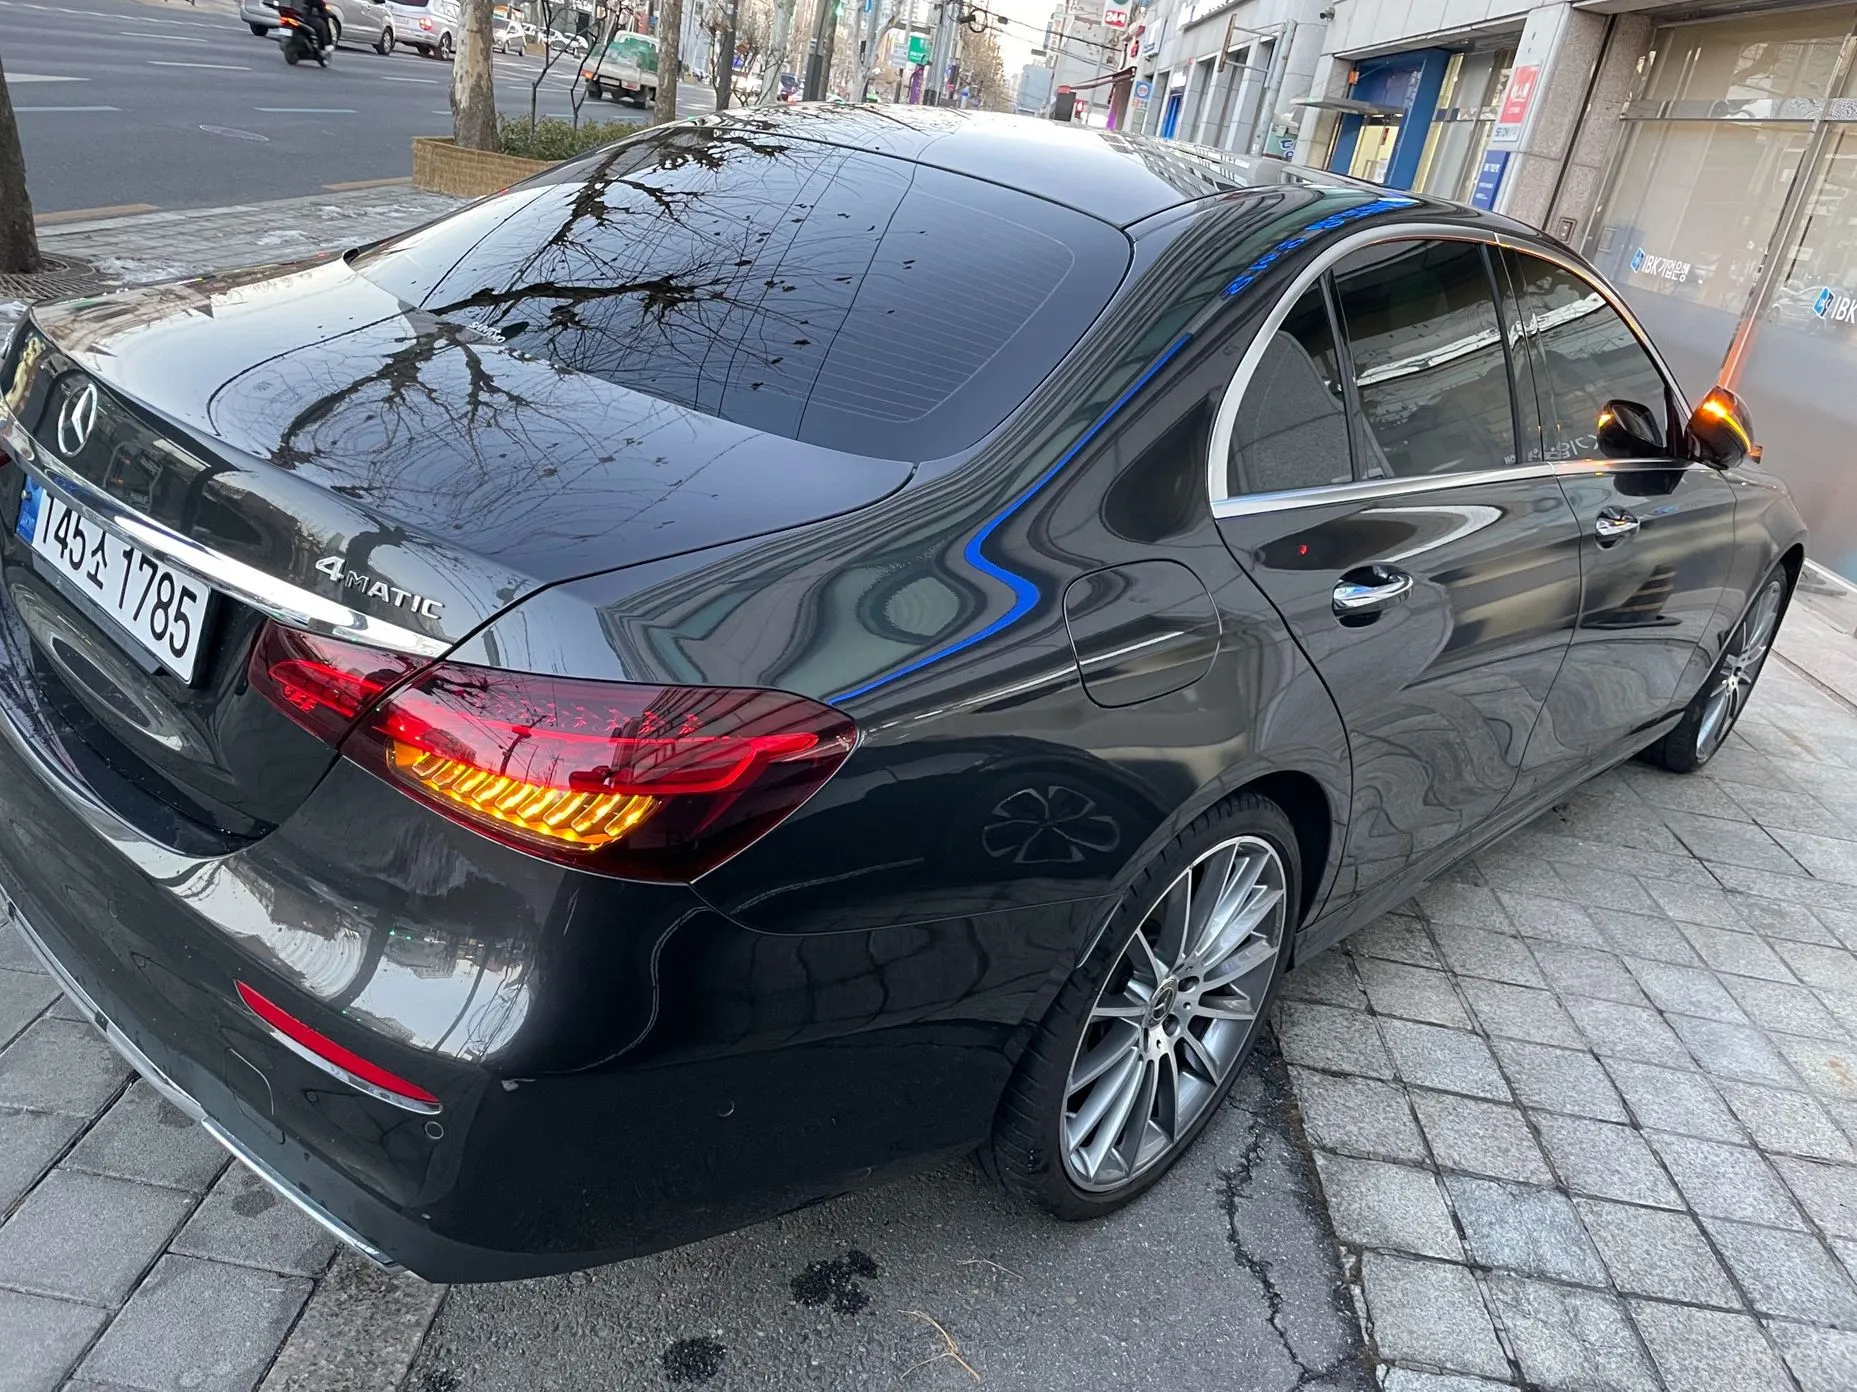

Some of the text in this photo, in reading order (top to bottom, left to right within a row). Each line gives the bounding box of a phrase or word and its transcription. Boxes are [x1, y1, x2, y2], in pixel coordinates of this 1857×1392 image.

[1641, 254, 1691, 283] IBK기업은행
[118, 546, 198, 659] 1785
[315, 555, 445, 620] 4MATIC
